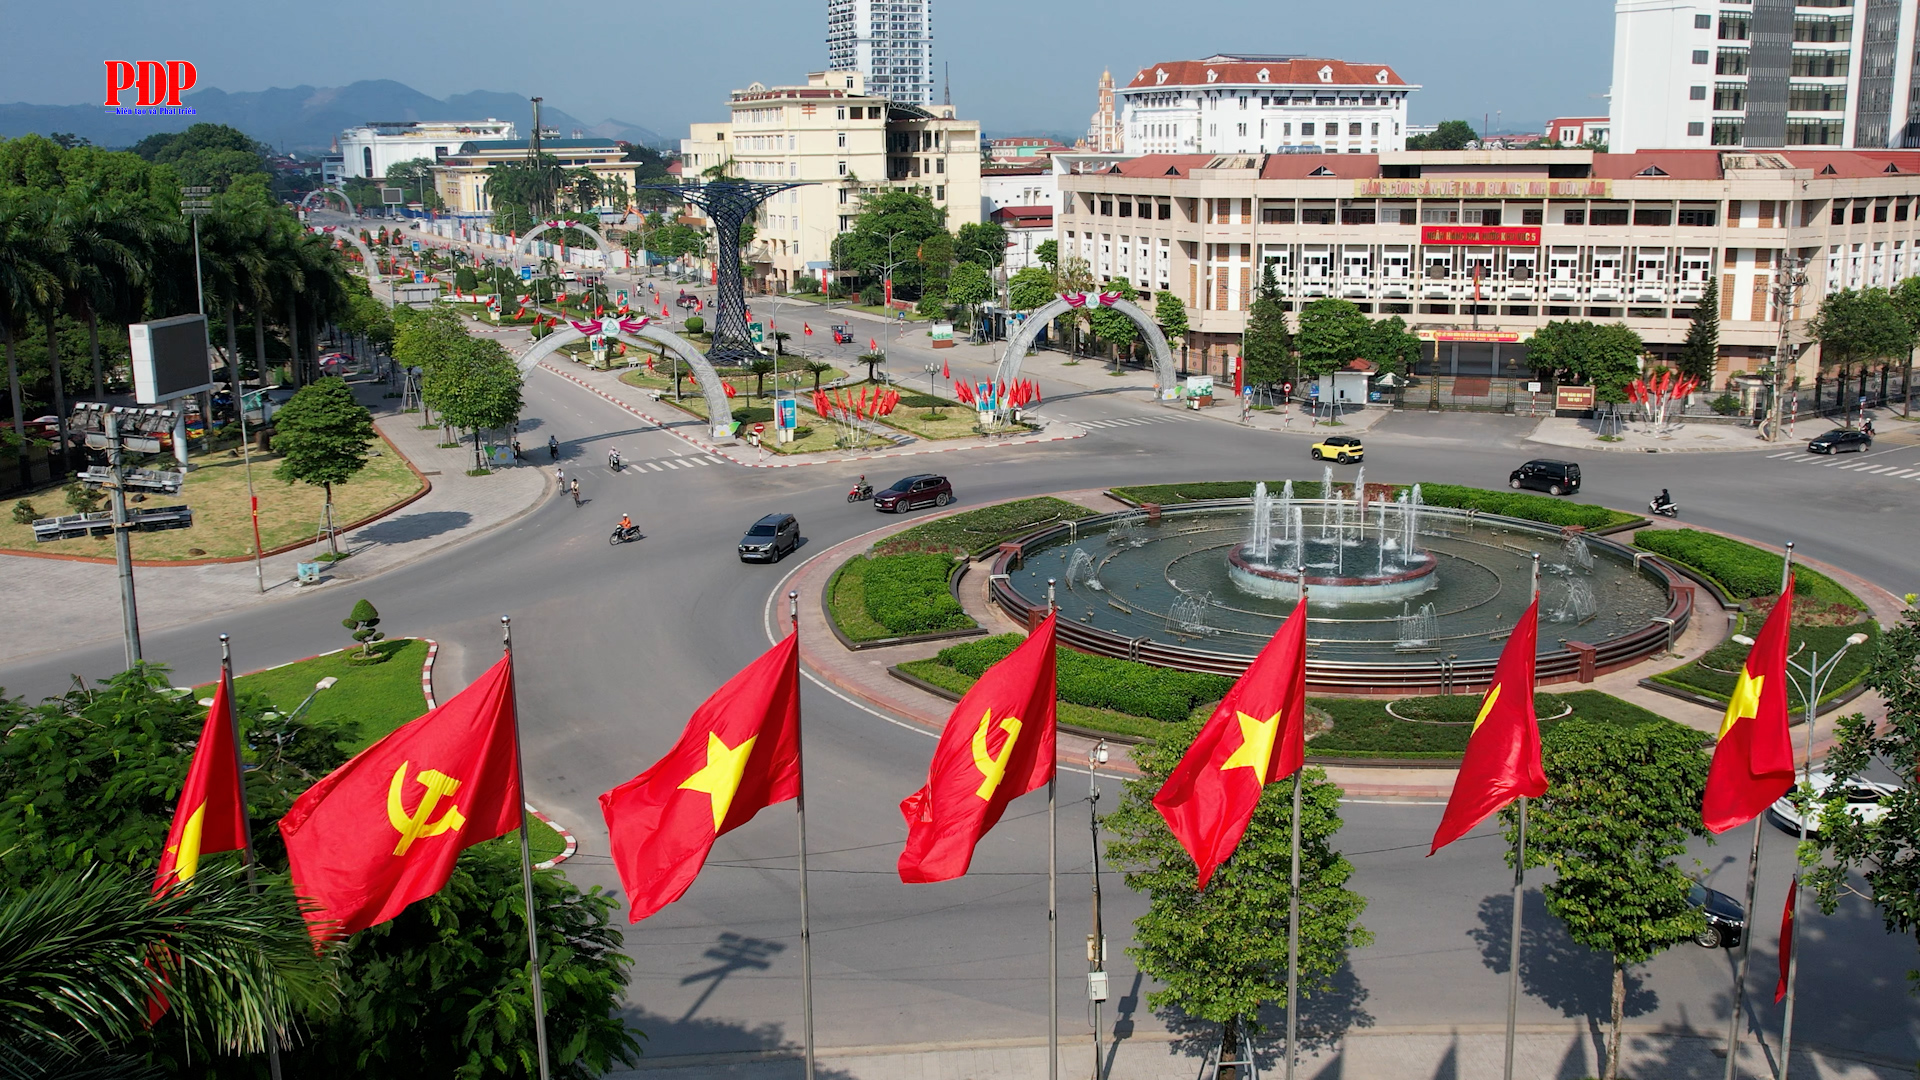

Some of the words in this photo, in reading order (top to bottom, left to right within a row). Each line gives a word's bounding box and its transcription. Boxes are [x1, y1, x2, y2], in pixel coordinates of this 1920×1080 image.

[1360, 178, 1387, 195] ĐẢNG
[1389, 180, 1415, 198] CỘNG
[1418, 179, 1438, 195] SẢN
[1440, 180, 1460, 198] VIỆT
[1463, 181, 1485, 196] NAM
[1488, 181, 1521, 196] QUANG
[1524, 181, 1547, 196] VINH
[1549, 180, 1579, 196] MUÔN
[1582, 180, 1606, 196] NĂM
[1531, 233, 1536, 241] 5
